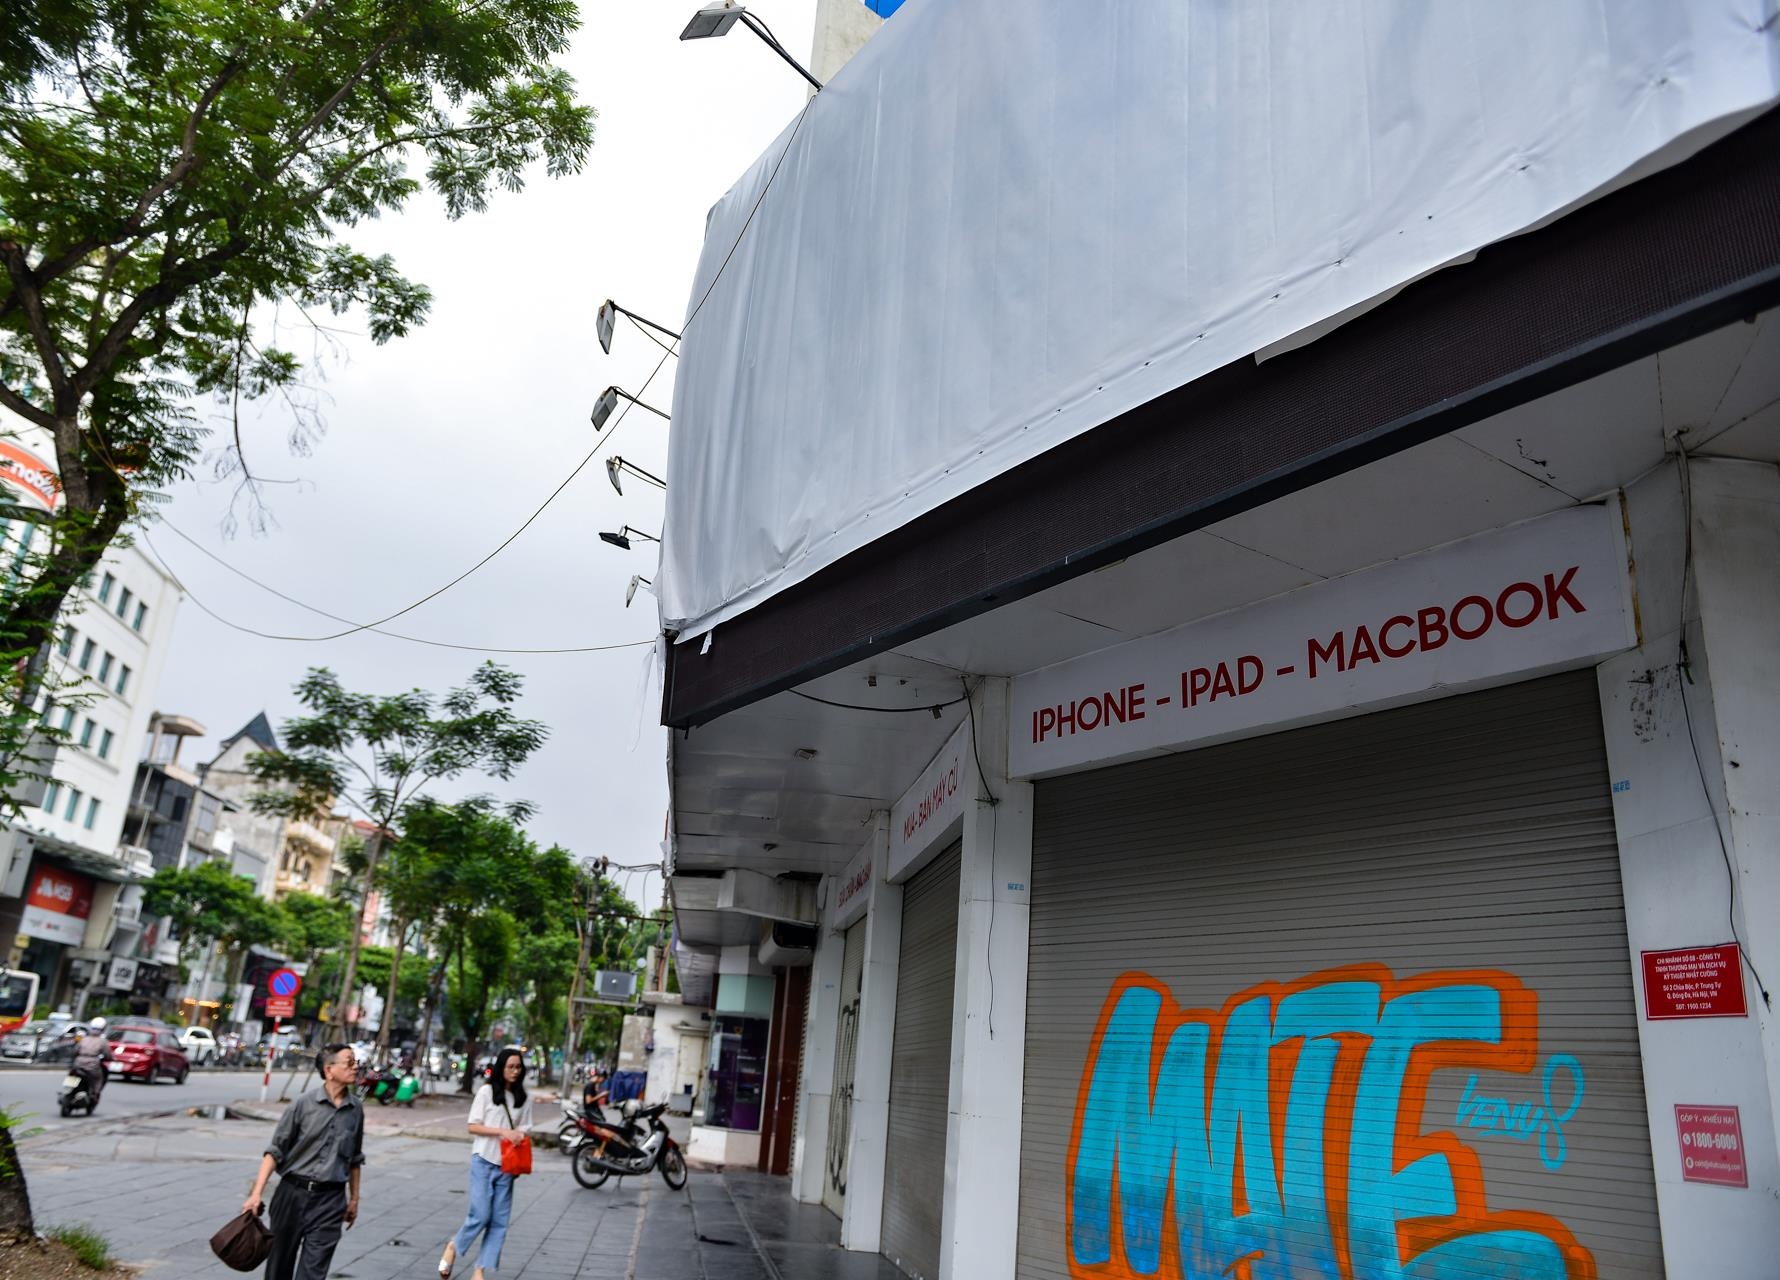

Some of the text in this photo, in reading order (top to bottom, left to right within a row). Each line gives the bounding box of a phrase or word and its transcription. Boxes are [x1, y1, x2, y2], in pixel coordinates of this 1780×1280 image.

[1033, 566, 1586, 743] IPHONE - IPAD - MACBOOK
[1713, 952, 1721, 960] TY
